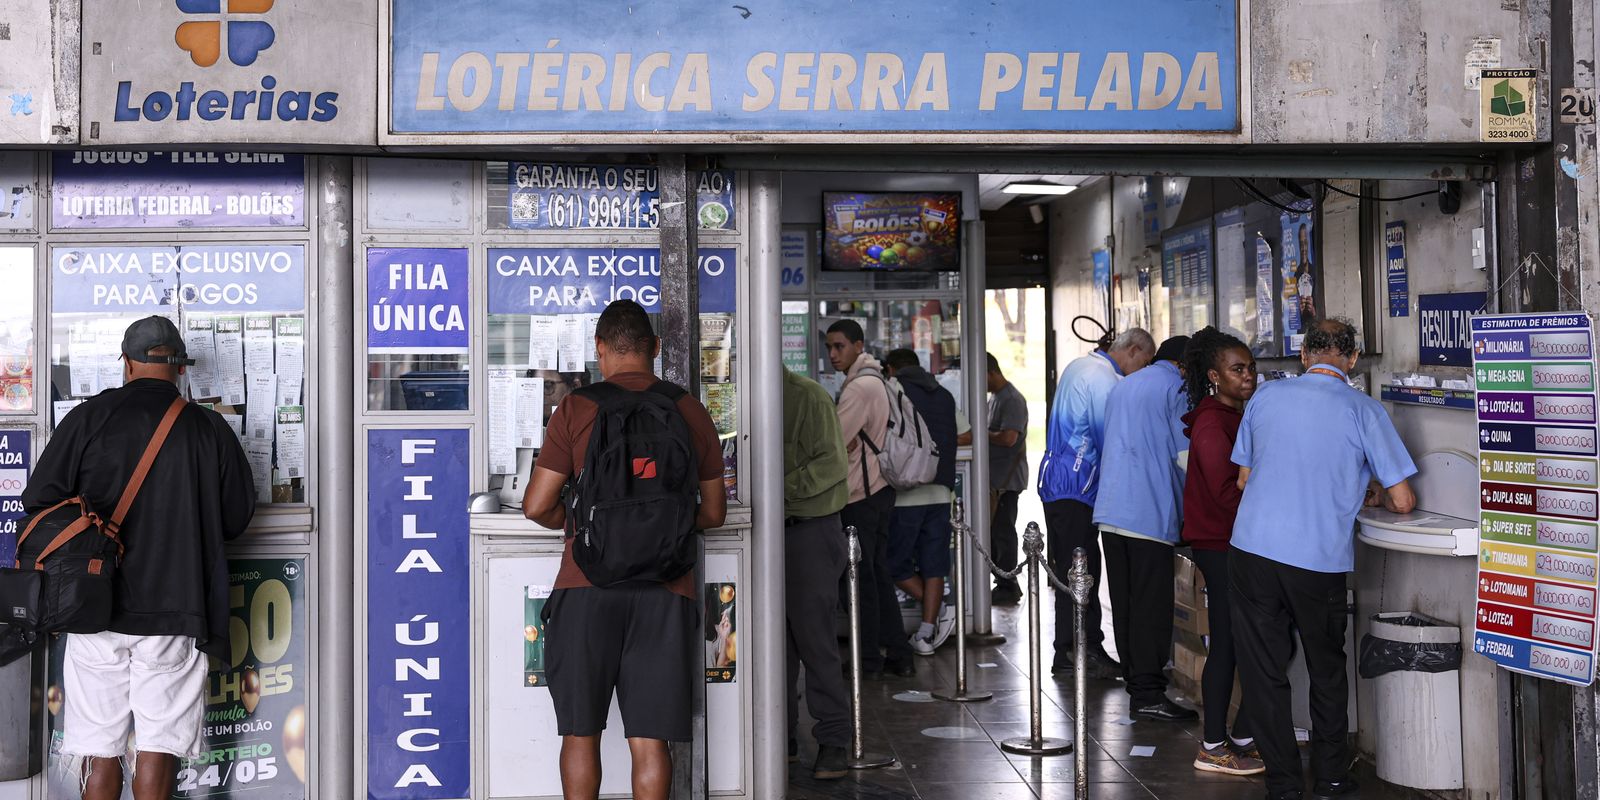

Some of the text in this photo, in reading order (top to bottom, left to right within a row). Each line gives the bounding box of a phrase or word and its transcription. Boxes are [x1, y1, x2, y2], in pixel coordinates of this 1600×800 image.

[415, 39, 1223, 112] LOTÉRICA SERRA PELADA
[114, 75, 339, 122] Loterias
[1488, 117, 1527, 126] ROMMA
[516, 165, 657, 192] GARANTA O SEU
[62, 195, 134, 216] LOTERIA
[138, 195, 211, 216] FEDERAL
[226, 191, 294, 216] BOLÕES
[548, 194, 659, 229] (61) 99611-5
[853, 215, 919, 233] BOLÕES
[58, 251, 292, 275] CAIXA EXCLUSIVO
[496, 255, 725, 277] CAIXA EXCLUO
[389, 264, 448, 290] FILA
[93, 283, 258, 305] PARA JOGOS
[529, 285, 661, 307] PARA JOG
[373, 298, 465, 332] ÚNICA
[1482, 317, 1578, 328] ESTIMATIVA DE PRÊMIOS
[1488, 369, 1525, 382] MEGA-SENA
[1489, 399, 1525, 414] LOTOFÁCIL
[1490, 430, 1511, 443] QUINA
[1493, 460, 1535, 475] DIA DE SORTE
[395, 439, 443, 573] FILA
[1492, 491, 1532, 505] DUPLA SENA
[1492, 521, 1532, 536] SUPER SETE
[1492, 551, 1528, 567] TIMEMANIA
[1490, 581, 1528, 598] LOTOMANIA
[1488, 611, 1513, 626] LOTECA
[1485, 640, 1514, 657] FEDERAL
[394, 614, 443, 788] ÚNICA
[215, 725, 233, 735] UM
[235, 719, 273, 733] BOLÃO
[176, 757, 278, 792] 24/05
